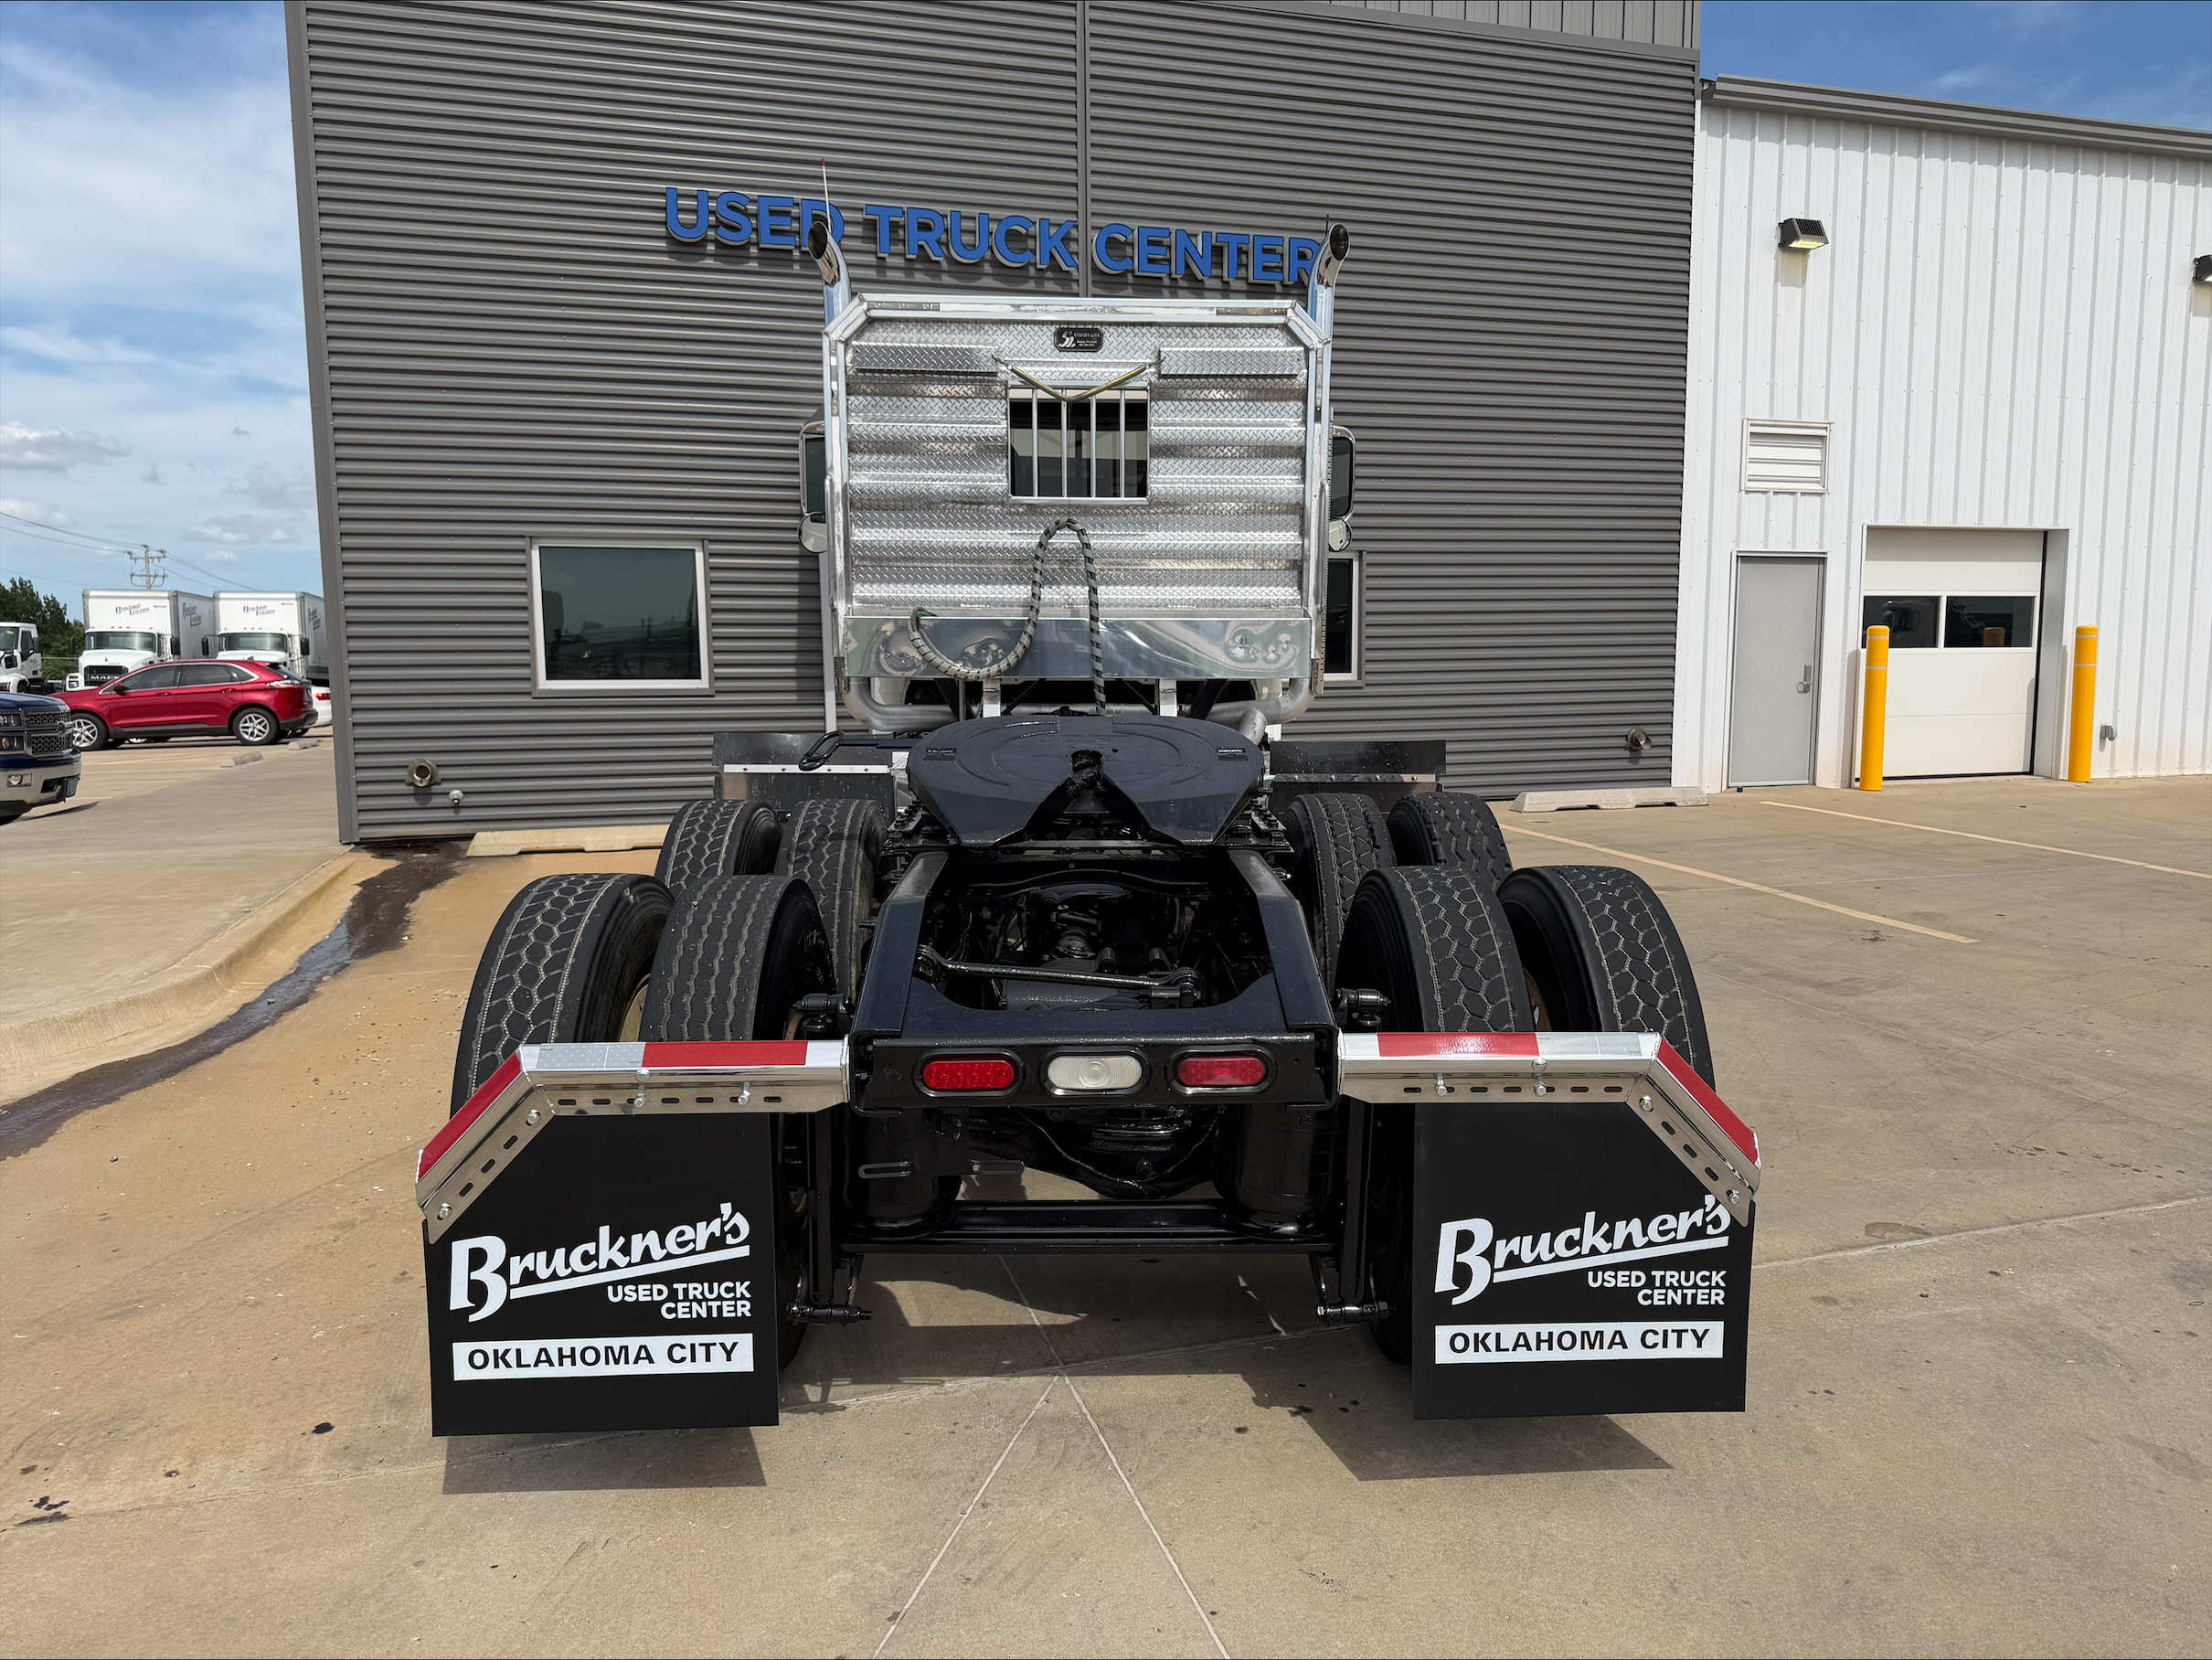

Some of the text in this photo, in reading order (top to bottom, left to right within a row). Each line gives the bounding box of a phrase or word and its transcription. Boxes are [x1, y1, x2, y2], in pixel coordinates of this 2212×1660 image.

[665, 186, 1321, 282] USED TRUCK CENTER
[449, 1201, 750, 1323] Bruckner's
[1434, 1195, 1732, 1306] Bruckner's
[607, 1281, 751, 1303] USED TRUCK
[1588, 1270, 1728, 1288] USED TRUCK
[660, 1300, 751, 1320] CENTER
[1637, 1288, 1725, 1306] CENTER
[1449, 1327, 1710, 1354] OKLAHOMA CITY
[467, 1341, 739, 1370] OKLAHOMA CITY
